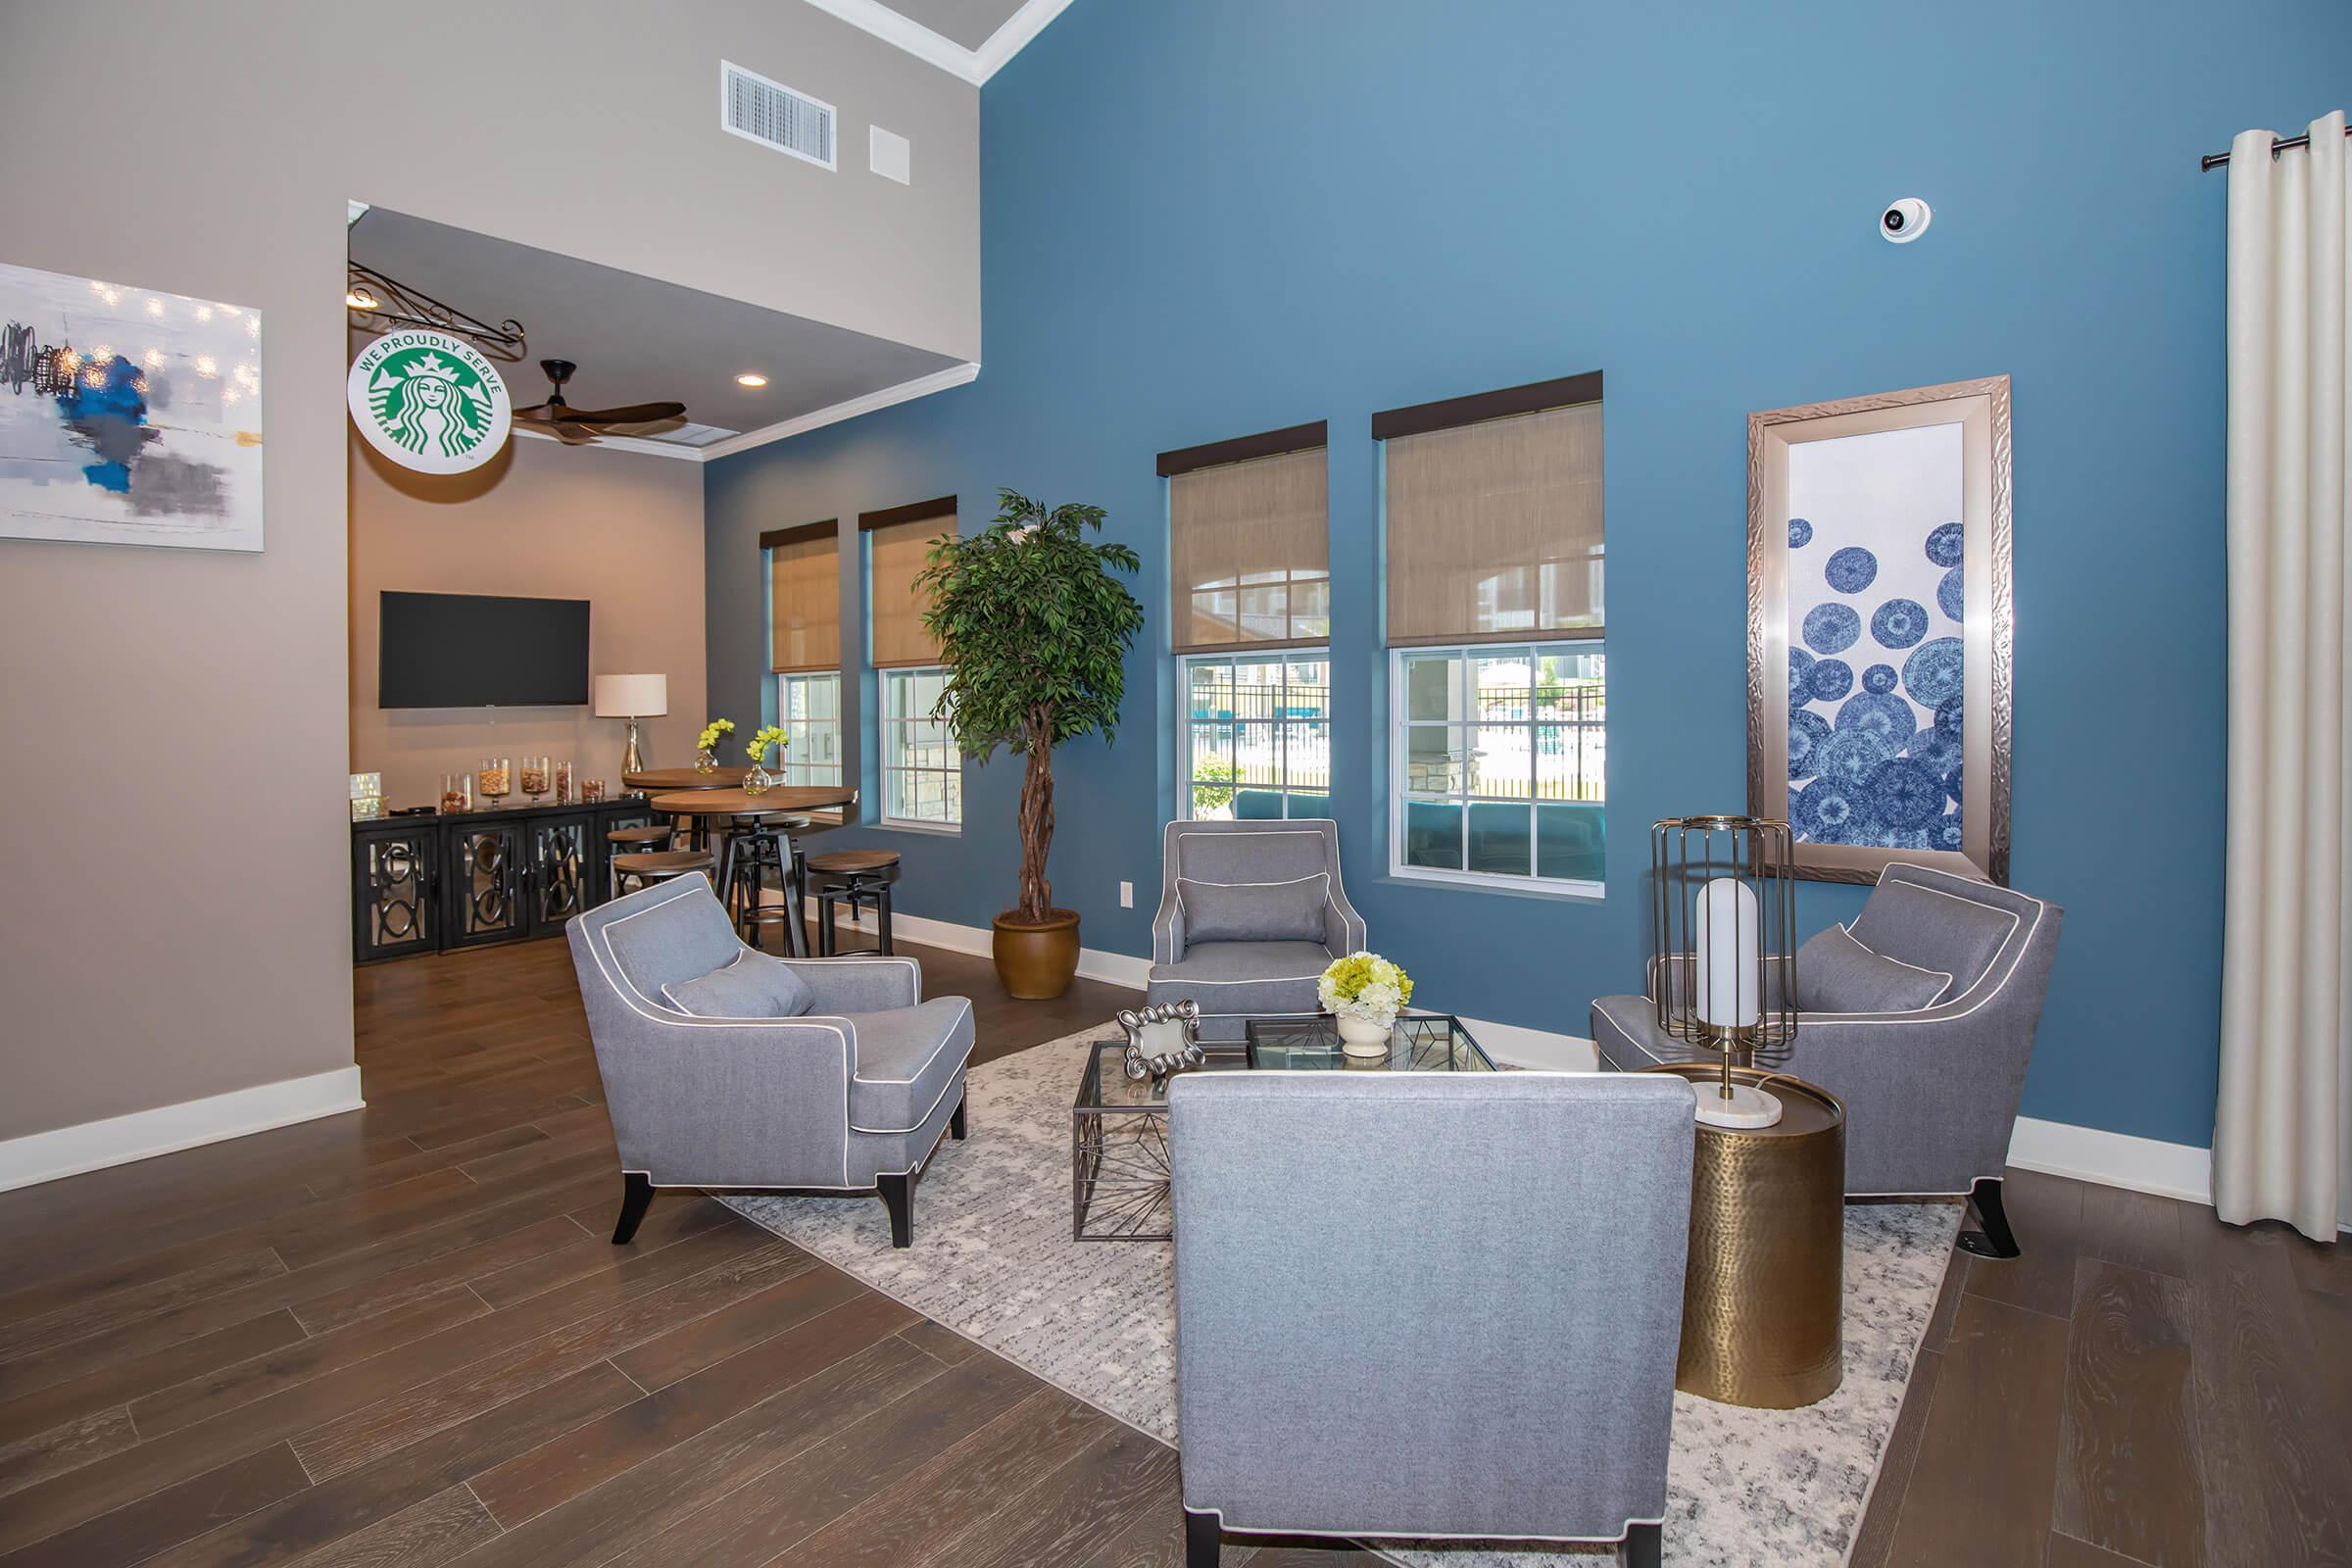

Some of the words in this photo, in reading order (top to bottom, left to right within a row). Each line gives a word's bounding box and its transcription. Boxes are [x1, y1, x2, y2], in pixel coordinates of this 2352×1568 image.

[360, 350, 381, 372] WE
[381, 334, 461, 353] PROUDLY
[464, 351, 502, 394] SERVE
